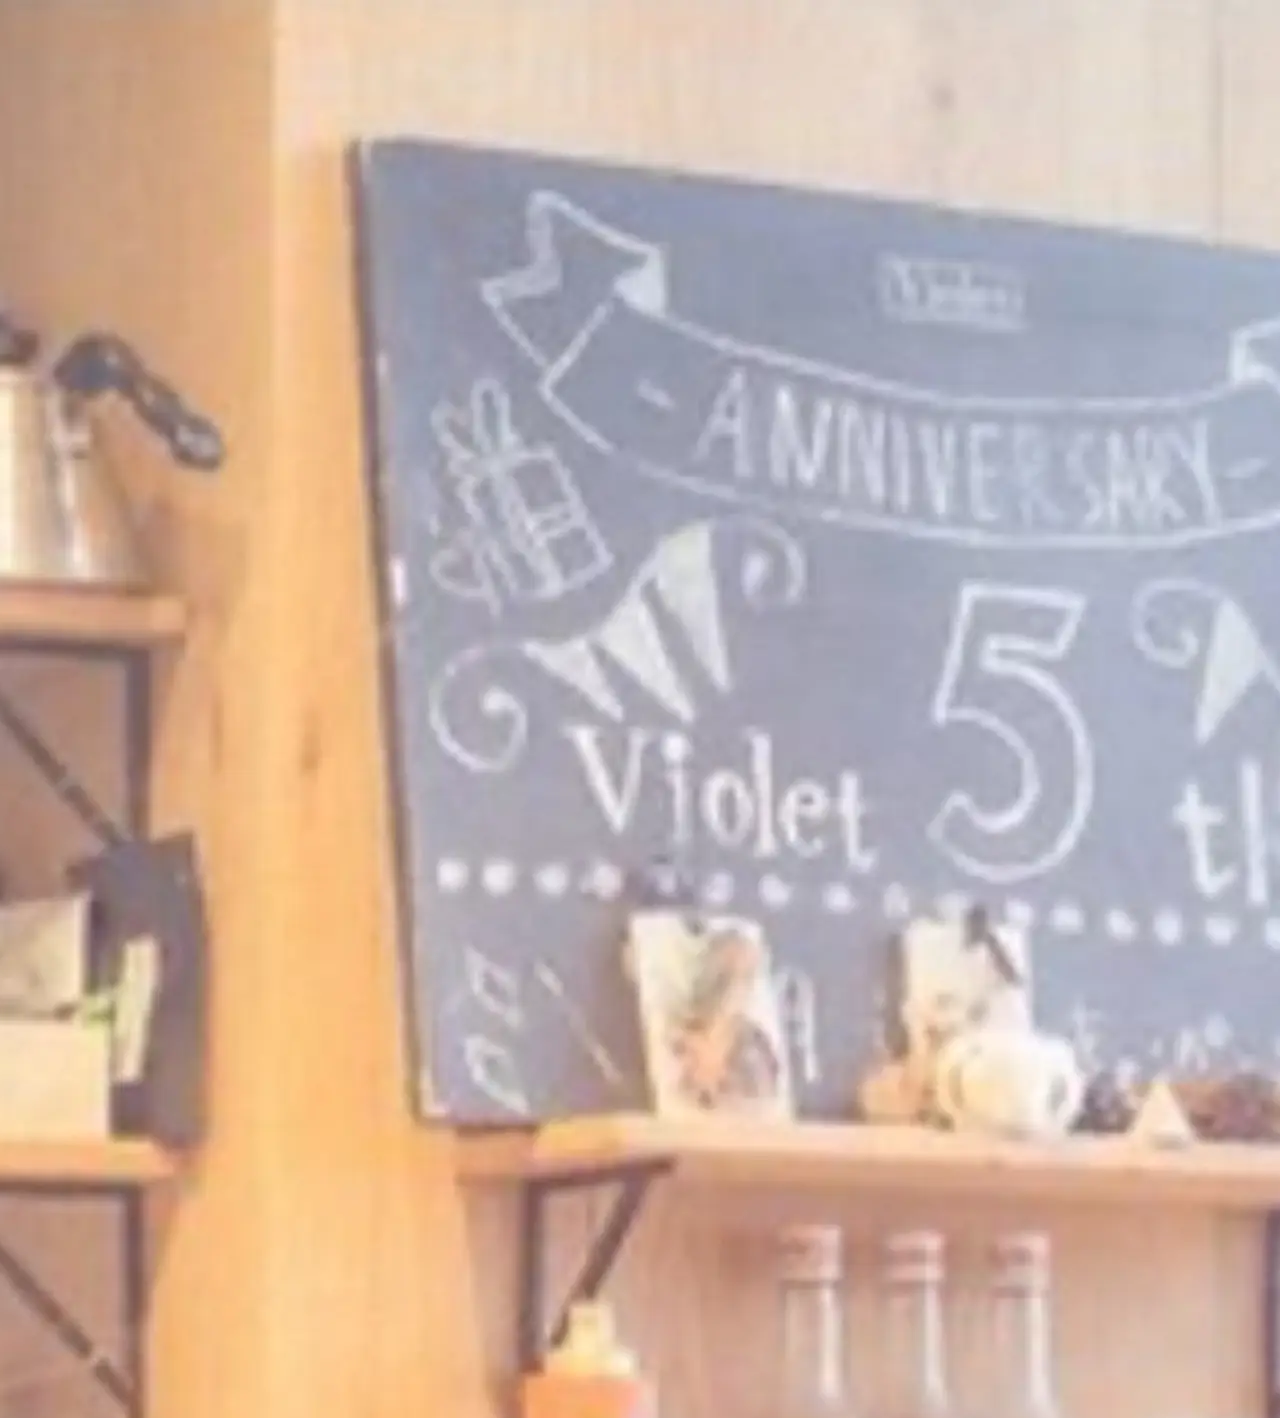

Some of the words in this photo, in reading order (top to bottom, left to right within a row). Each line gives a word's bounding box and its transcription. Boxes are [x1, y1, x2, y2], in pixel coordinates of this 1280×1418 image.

[692, 366, 1219, 529] ANNIVERSARY
[564, 724, 877, 873] Violet
[928, 580, 1094, 884] 5
